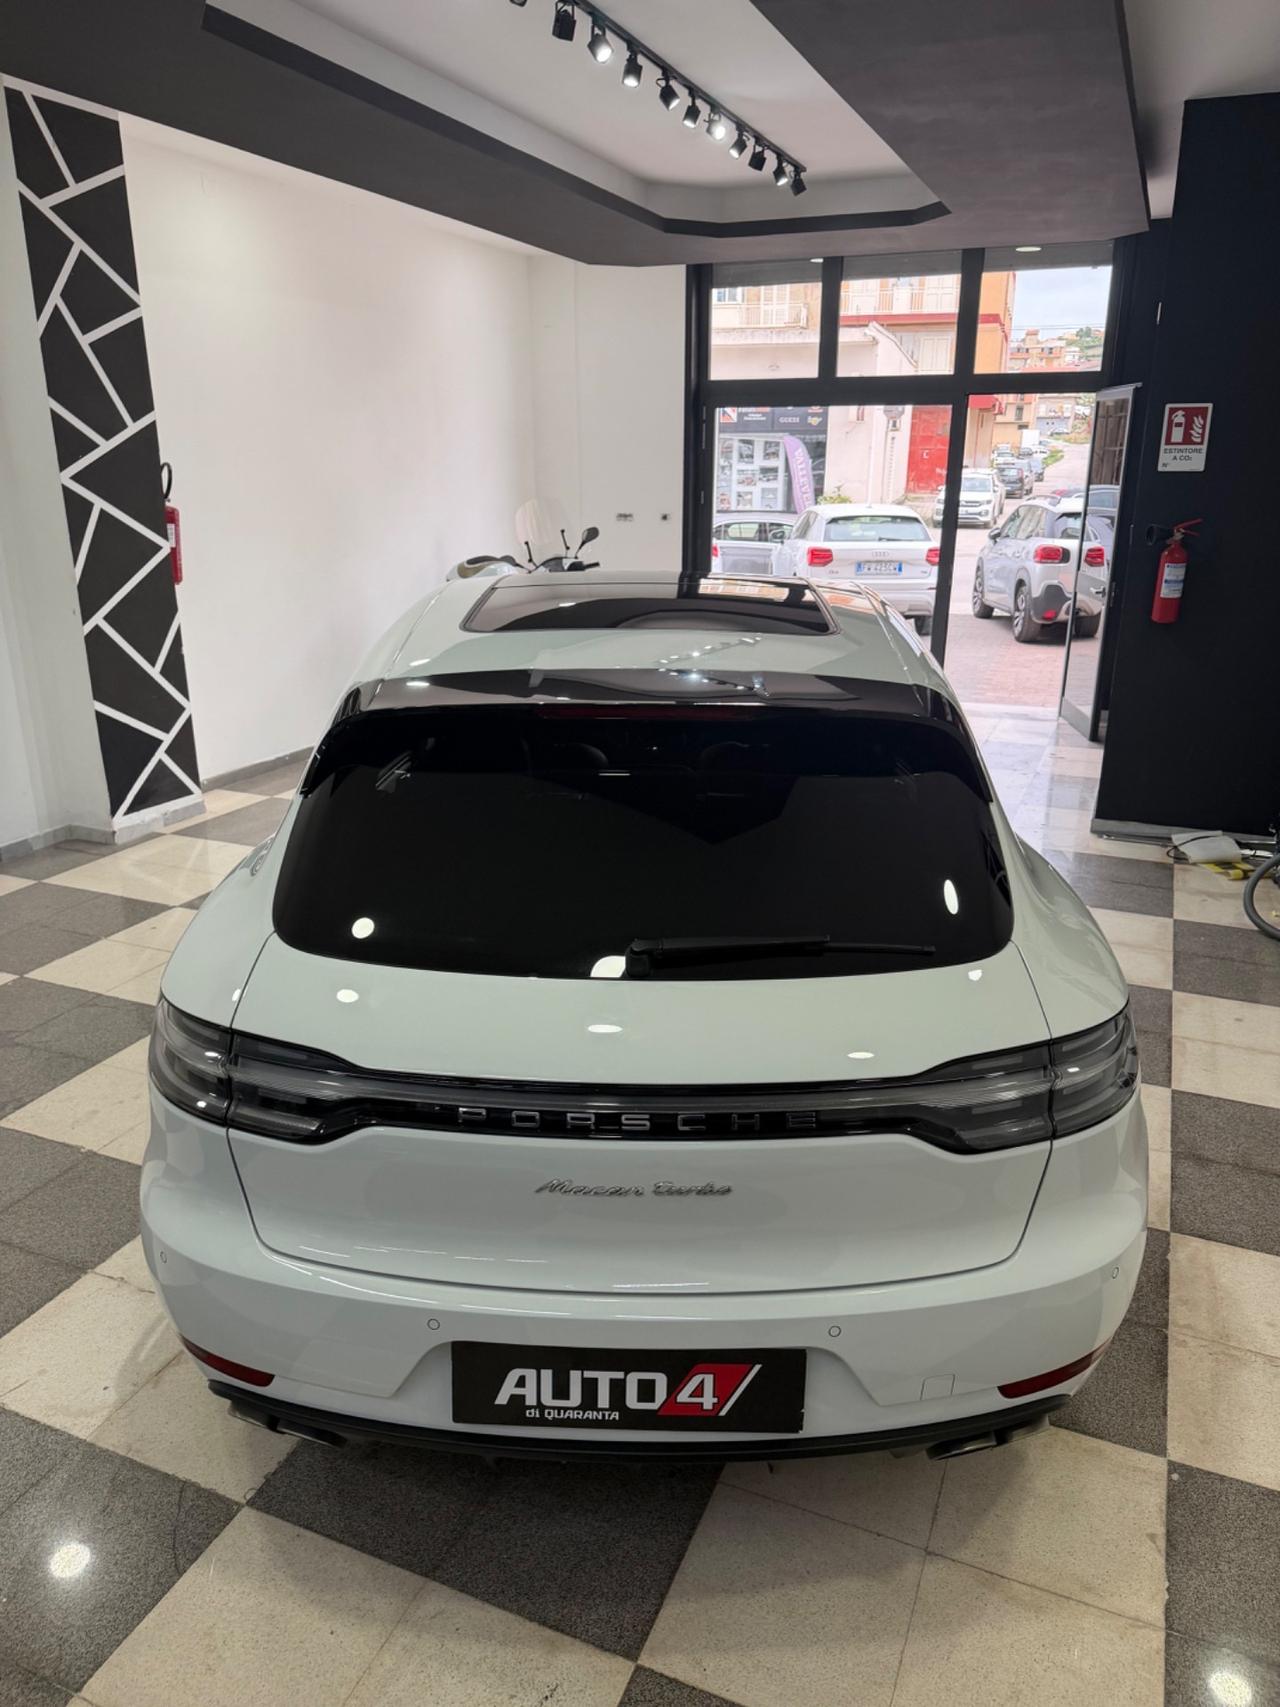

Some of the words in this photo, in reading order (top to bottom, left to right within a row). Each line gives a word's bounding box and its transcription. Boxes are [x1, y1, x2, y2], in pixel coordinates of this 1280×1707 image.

[458, 1107, 816, 1131] PORSCHE
[534, 1178, 645, 1197] Macan
[652, 1181, 733, 1197] Turbo
[525, 1408, 540, 1418] di
[544, 1408, 620, 1421] QUARANTA
